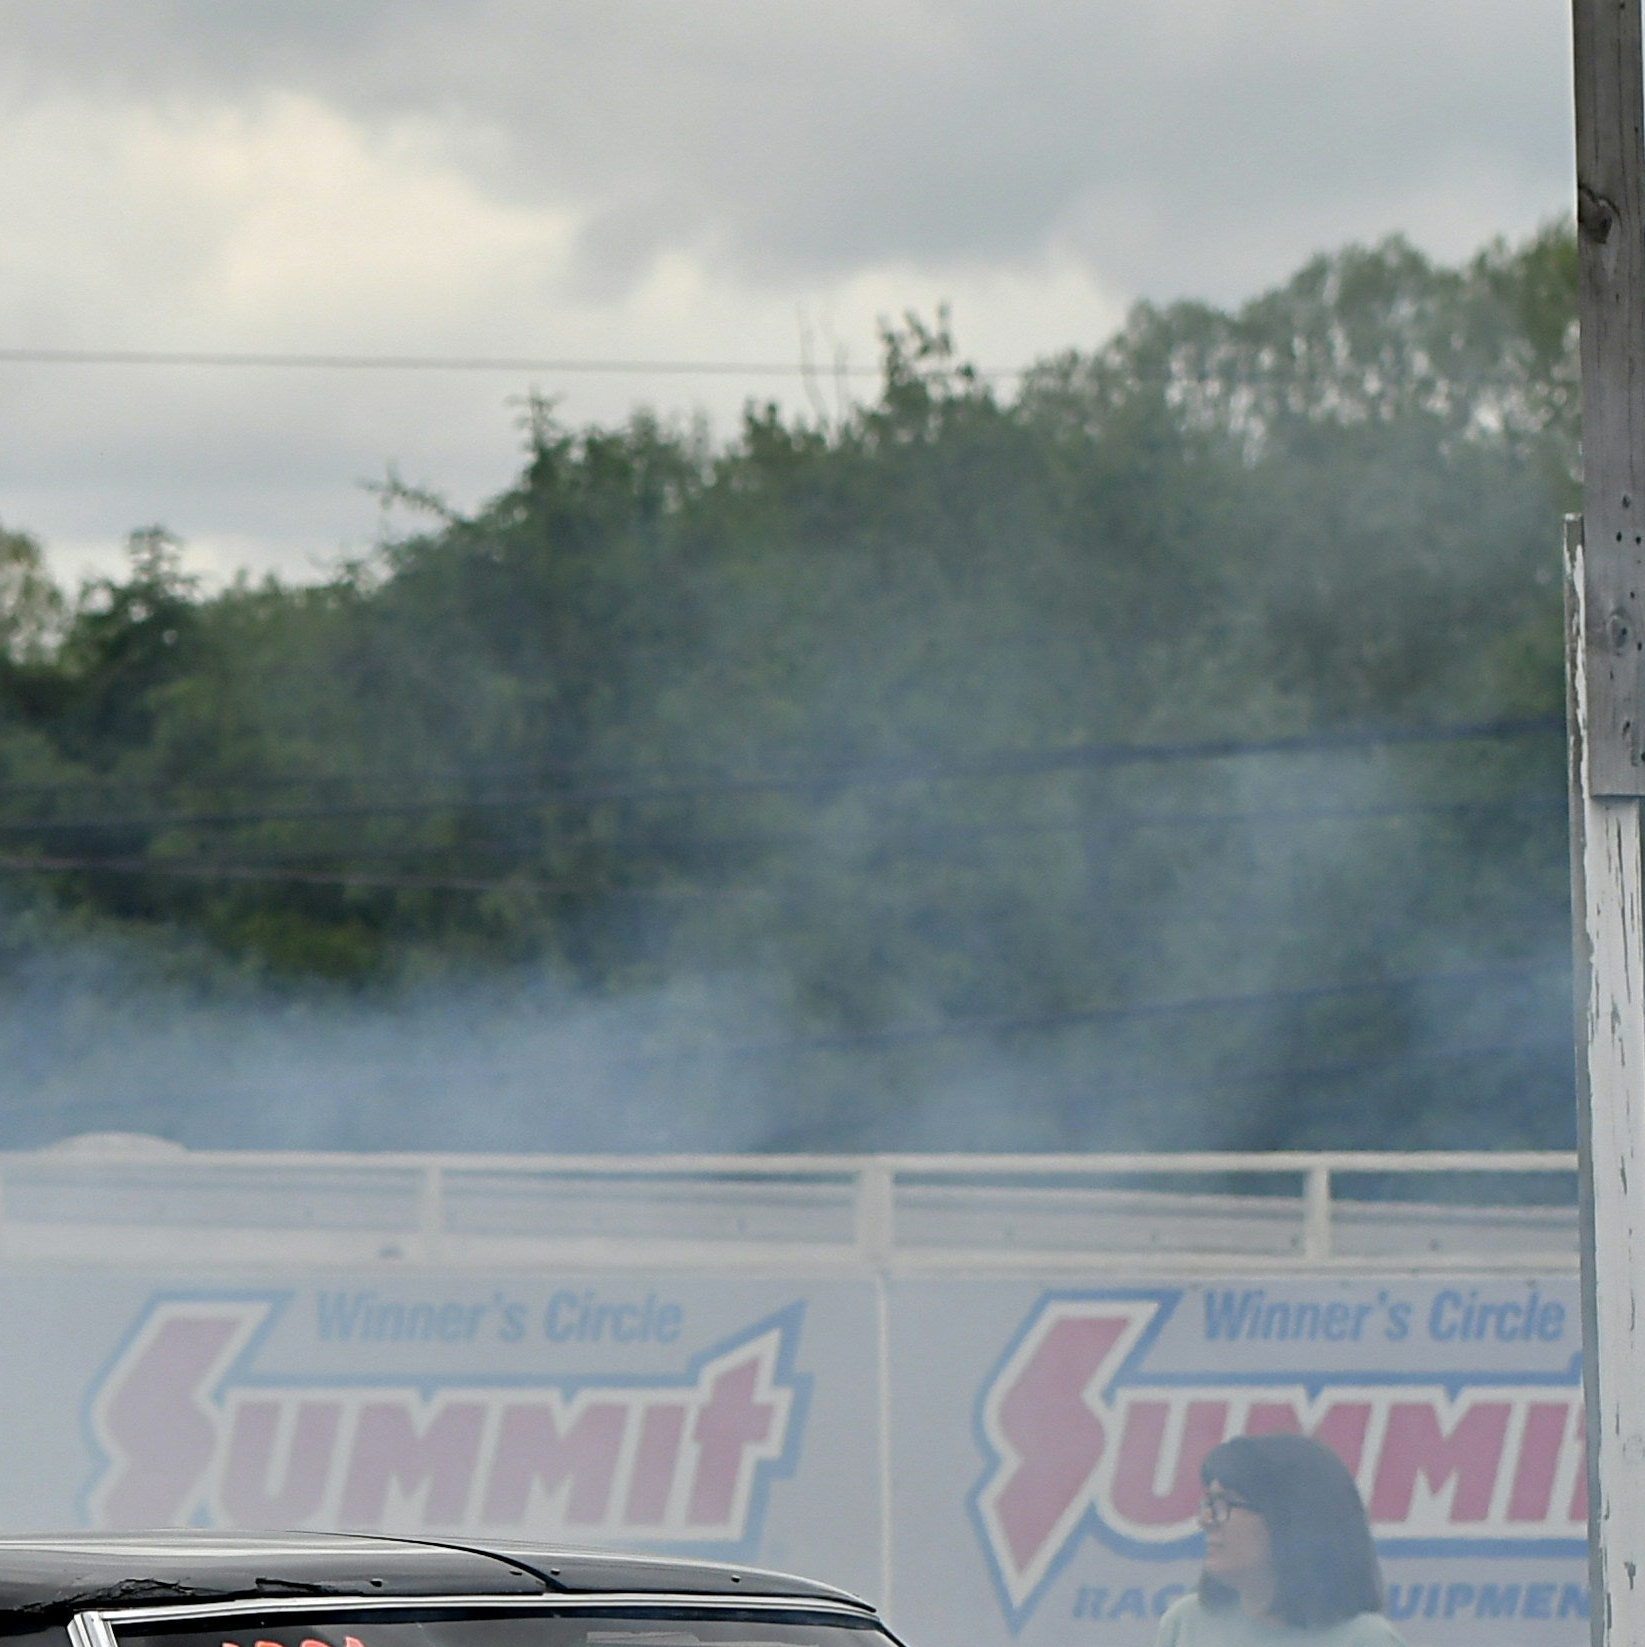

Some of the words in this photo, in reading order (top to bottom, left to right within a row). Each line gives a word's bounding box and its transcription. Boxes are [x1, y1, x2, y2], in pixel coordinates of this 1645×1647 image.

[316, 1289, 529, 1344] Winner's
[543, 1289, 684, 1344] Circle
[1203, 1290, 1412, 1342] Winner's
[1428, 1292, 1566, 1343] Circle
[1386, 1583, 1589, 1619] UIPMEN
